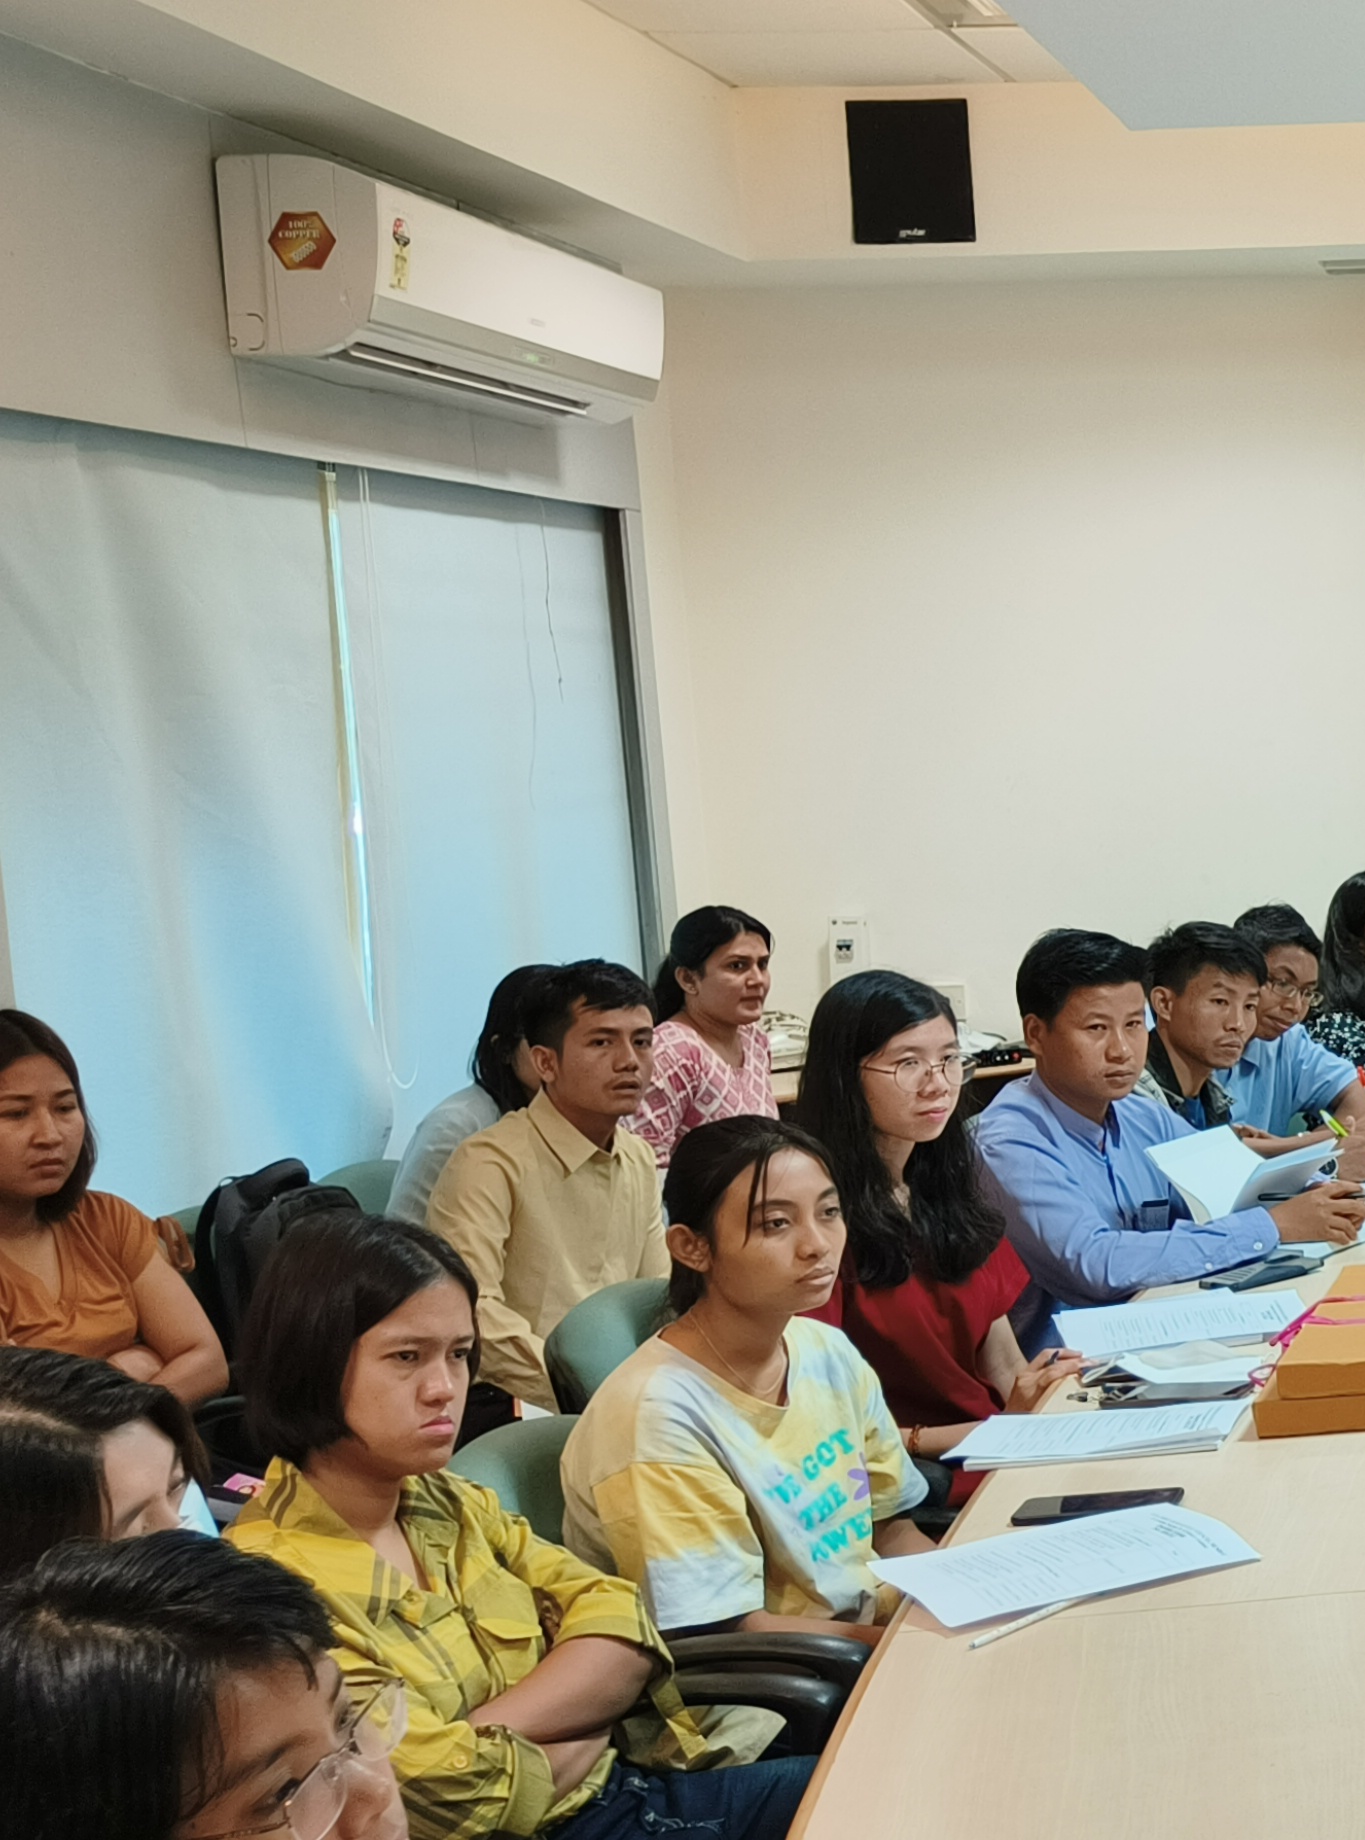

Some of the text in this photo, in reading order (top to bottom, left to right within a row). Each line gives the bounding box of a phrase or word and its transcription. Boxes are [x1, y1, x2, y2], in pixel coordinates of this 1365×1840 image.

[278, 229, 320, 239] COPPER
[802, 1428, 855, 1481] GOT
[797, 1482, 848, 1531] THE
